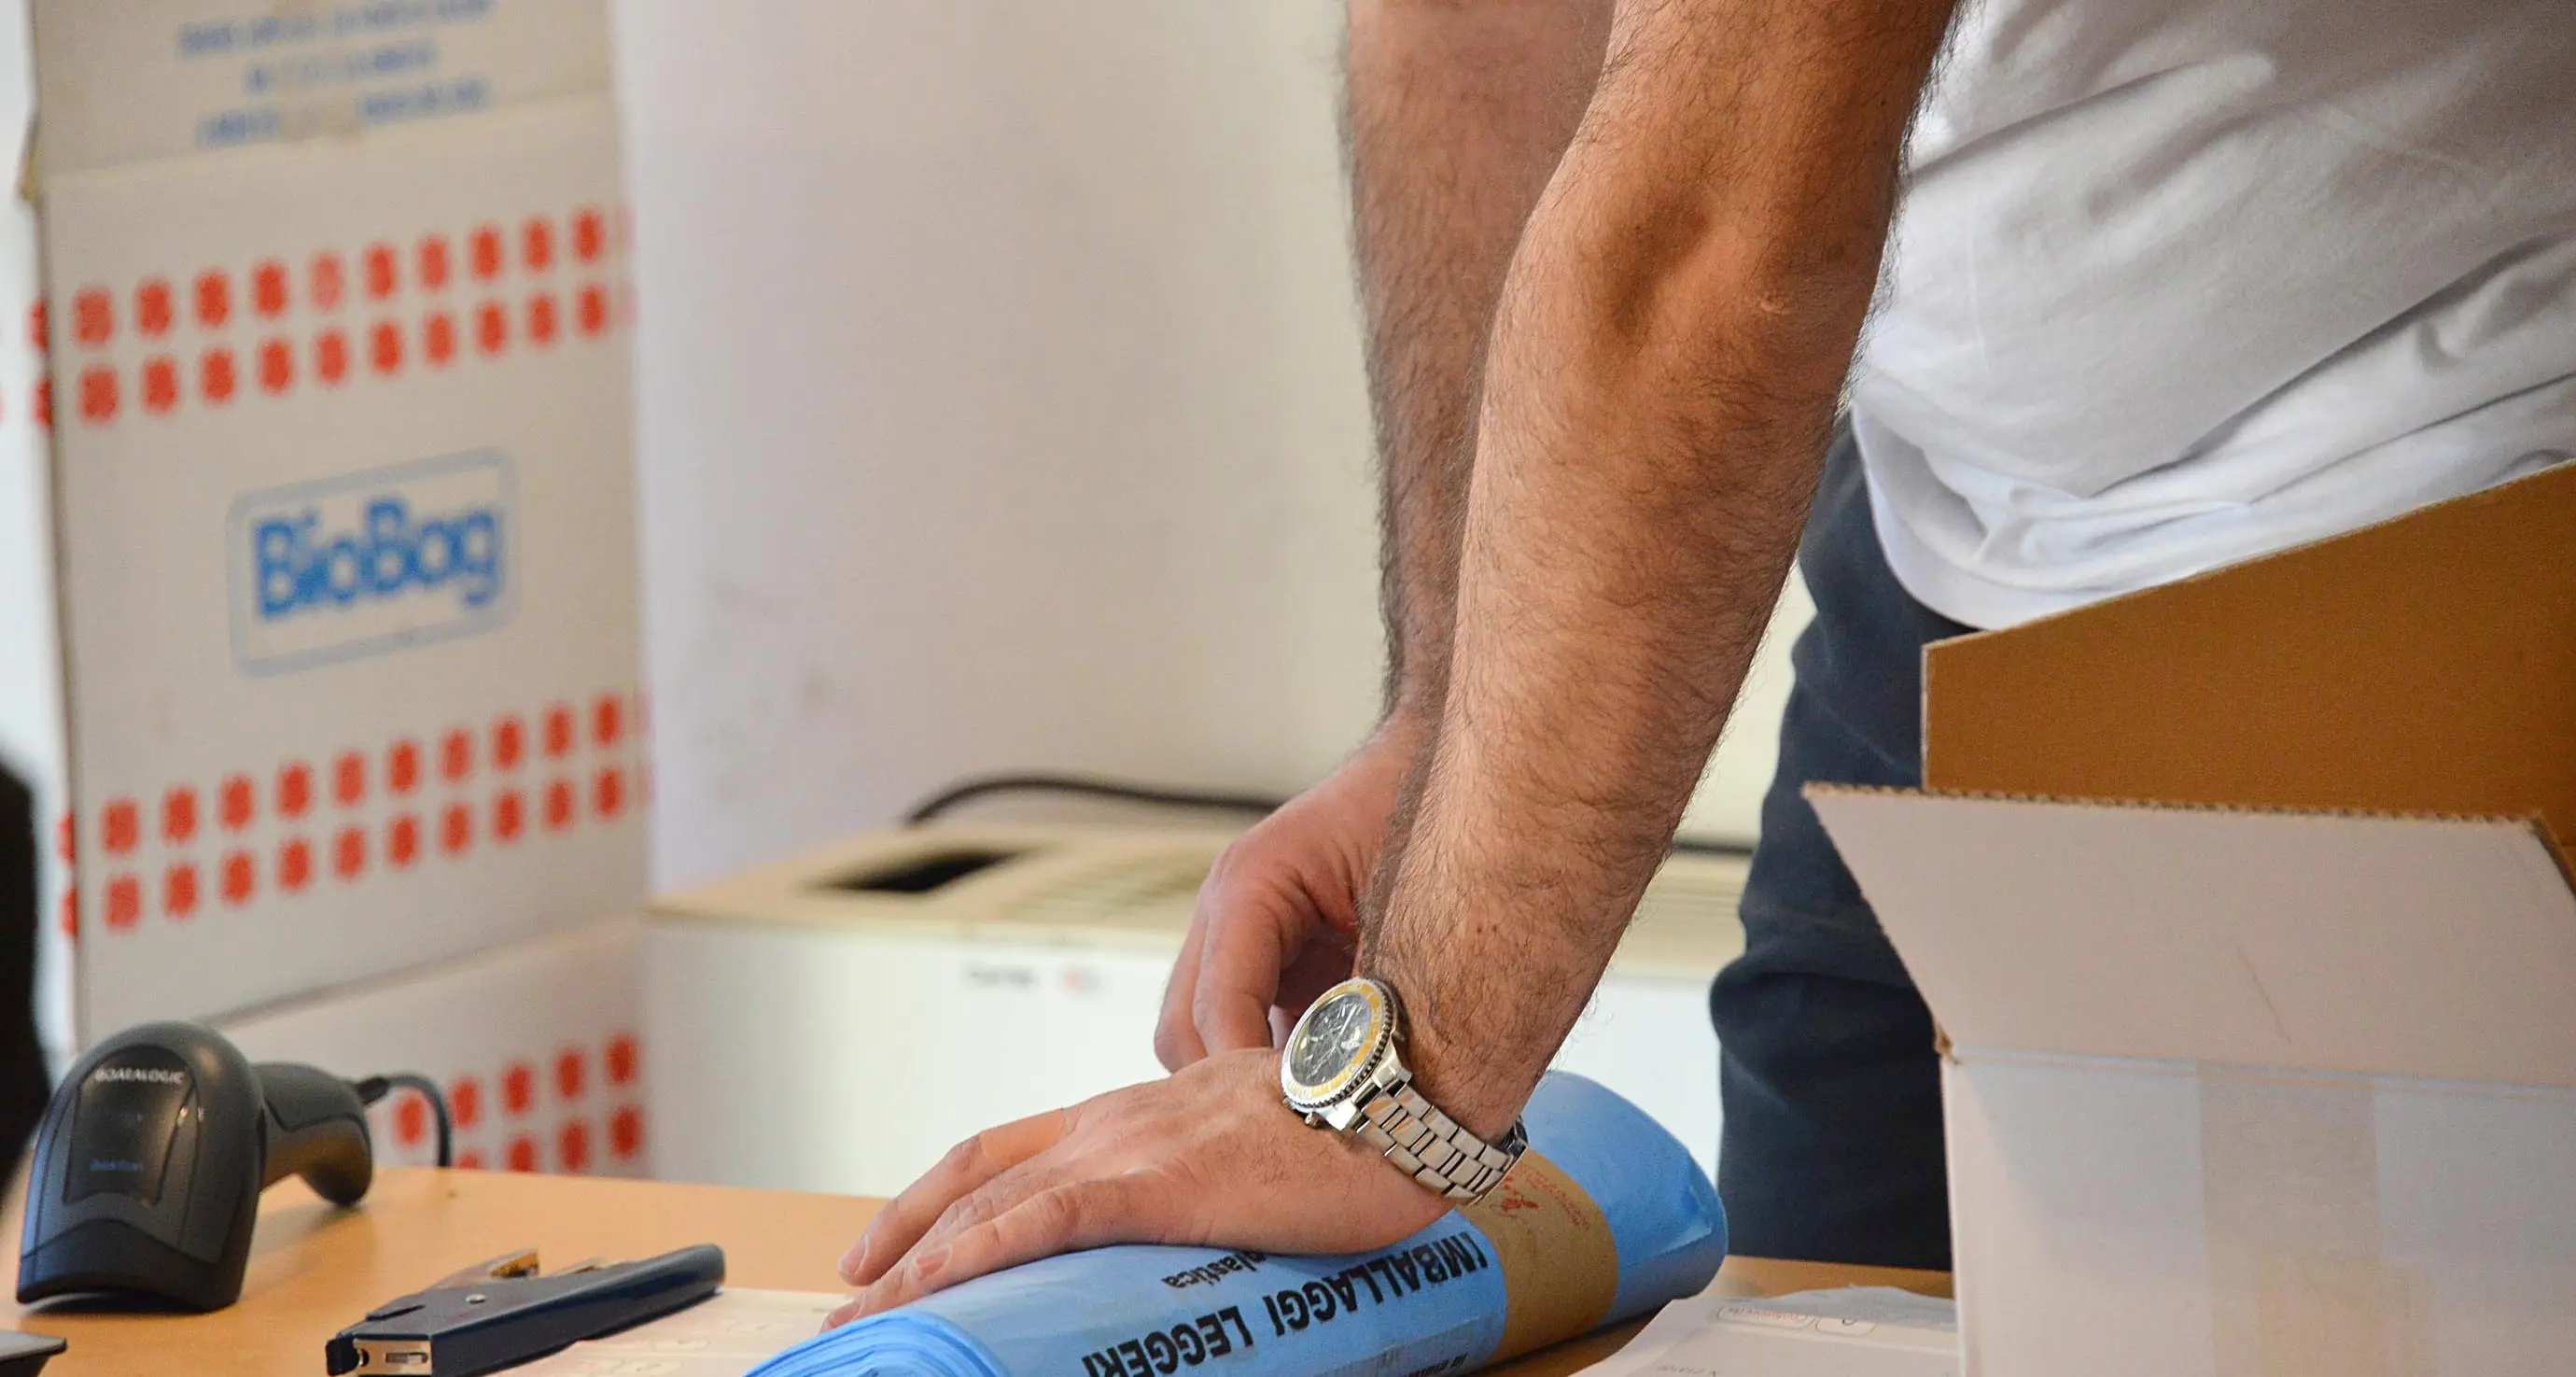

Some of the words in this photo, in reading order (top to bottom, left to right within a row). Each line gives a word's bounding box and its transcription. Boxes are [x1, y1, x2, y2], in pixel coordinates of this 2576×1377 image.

[254, 499, 499, 620] BioBag
[1262, 1231, 1489, 1337] IMBALLAGGI
[1081, 1305, 1253, 1377] LEGGERI
